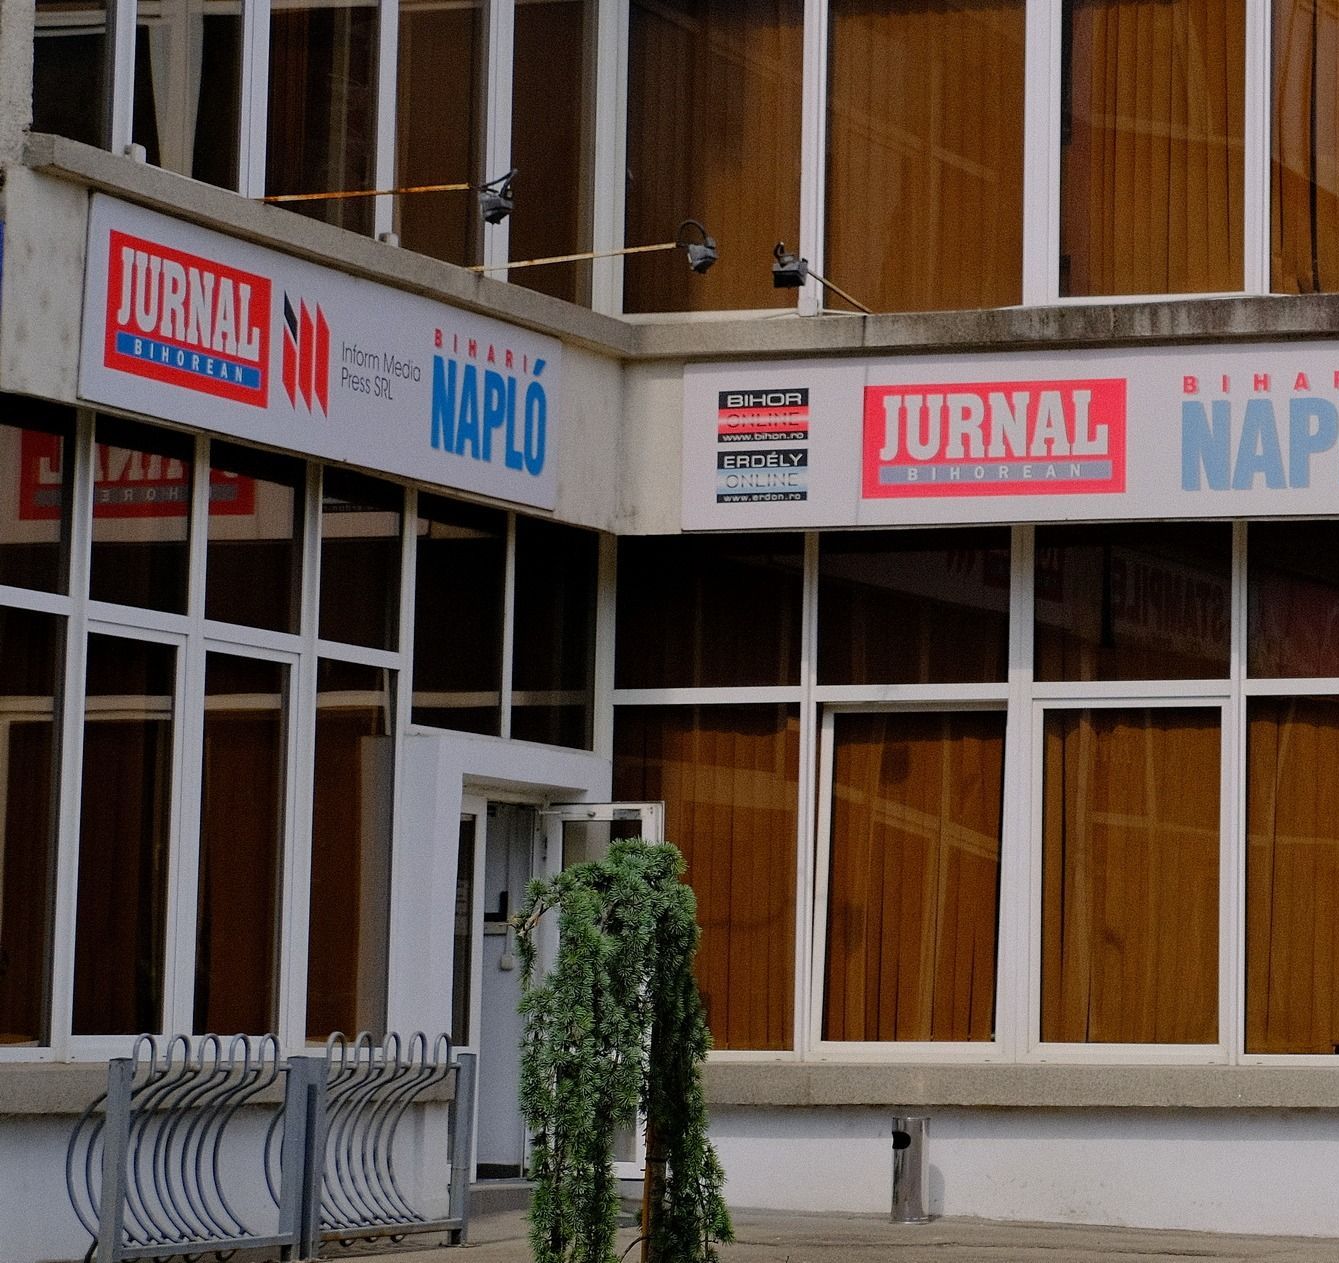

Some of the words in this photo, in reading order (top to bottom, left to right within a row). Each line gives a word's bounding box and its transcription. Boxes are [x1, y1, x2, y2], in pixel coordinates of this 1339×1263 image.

[117, 246, 260, 362] JURNAL
[133, 338, 244, 382] BIHOREAN
[342, 341, 380, 370] Inform
[383, 352, 421, 382] Media
[433, 328, 528, 373] BIHARI
[341, 366, 371, 394] Press
[374, 376, 393, 400] SRL
[727, 393, 801, 407] BIHOR
[430, 355, 547, 477] NAPLÓ
[727, 412, 800, 428] ONLINE
[880, 389, 1108, 462] JURNAL
[722, 432, 804, 441] www.bihon.ro
[723, 451, 802, 468] ERDÉLY
[908, 463, 1082, 482] BIHOREAN
[726, 473, 798, 488] ONLINE
[723, 493, 801, 502] www.erdon.ro
